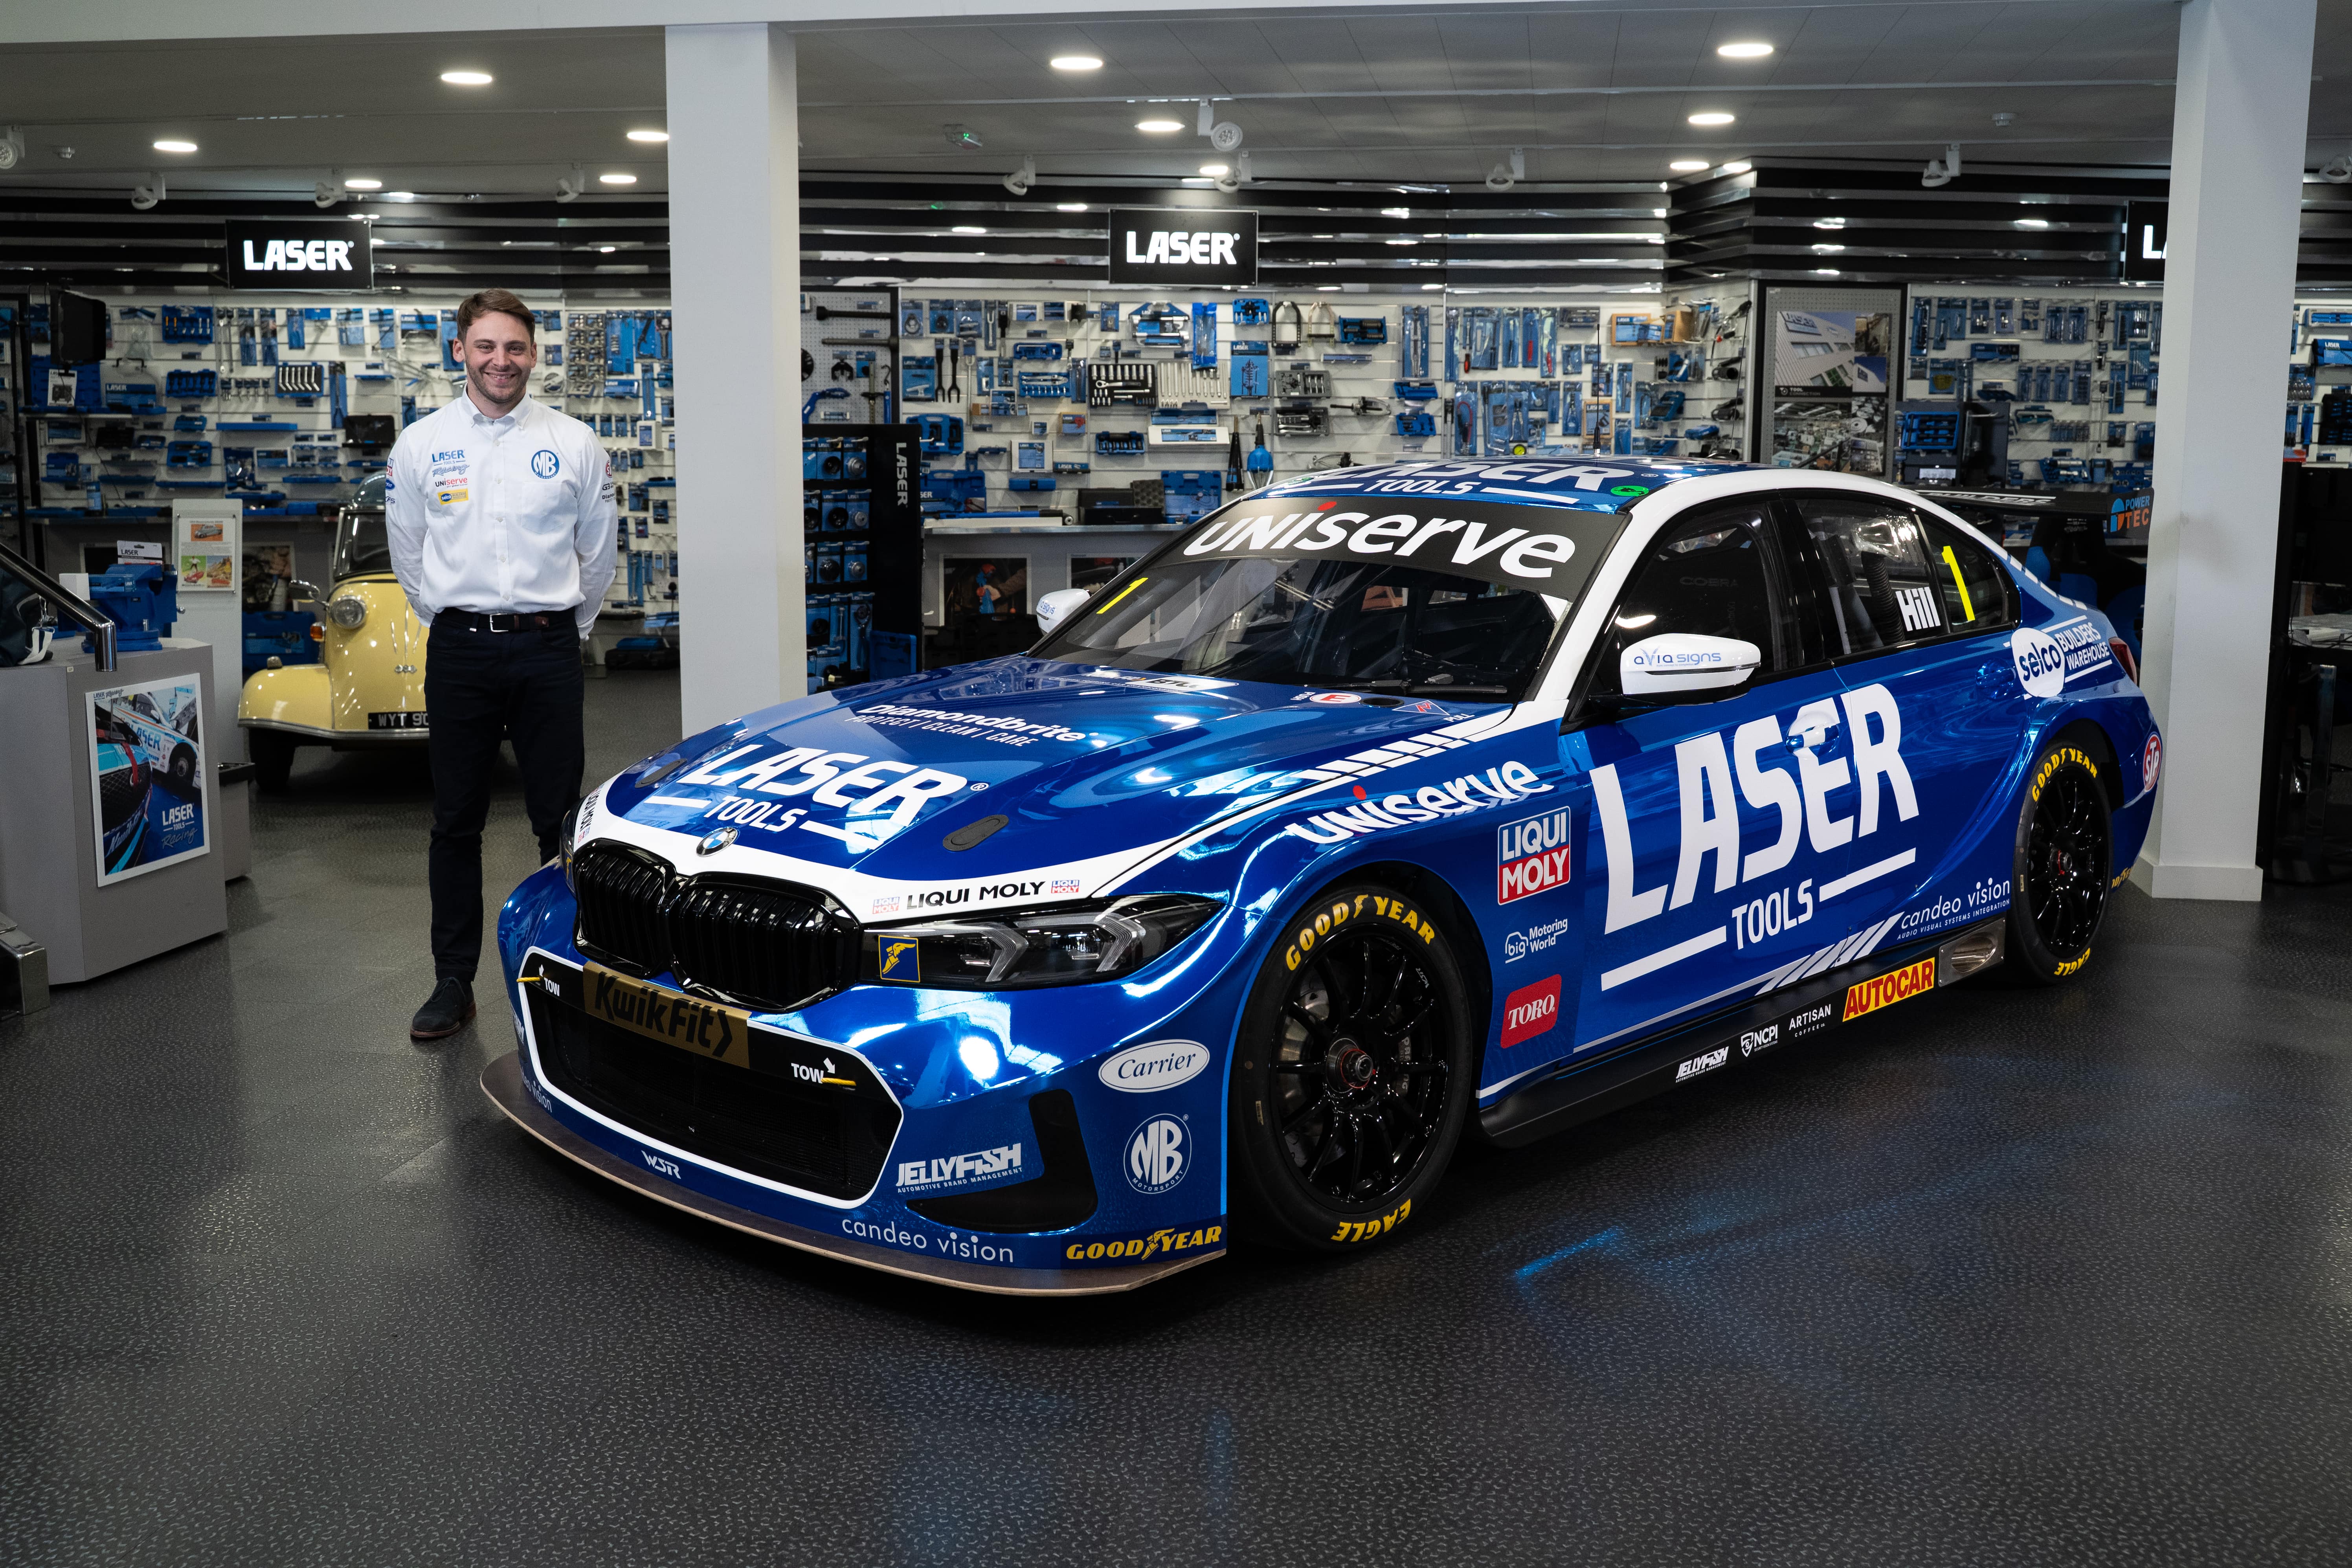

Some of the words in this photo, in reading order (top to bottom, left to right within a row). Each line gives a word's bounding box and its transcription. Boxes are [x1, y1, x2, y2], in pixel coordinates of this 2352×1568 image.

[243, 240, 353, 271] LASER
[1126, 231, 1237, 265] LASER
[431, 449, 465, 463] LASER
[896, 442, 908, 507] LASER
[1364, 479, 1482, 494] TOOLS
[441, 493, 452, 501] selco
[2125, 495, 2150, 510] POWER
[2125, 508, 2149, 529] TEC
[1096, 577, 1148, 614] 1
[1941, 545, 1975, 621] 1
[1895, 586, 1941, 632] Hill
[2054, 622, 2100, 652] BUILDERS
[1676, 652, 1722, 665] signs
[2018, 633, 2061, 681] selco
[2066, 642, 2110, 670] WAREHOUSE
[378, 713, 407, 726] WYT
[844, 715, 921, 727] PROTECT
[922, 719, 977, 736] CLEAN
[986, 732, 1039, 747] CARE
[856, 704, 1087, 742] Diamondbrite
[1443, 713, 1475, 722] PULL
[2145, 740, 2160, 786] STP
[676, 744, 968, 827] LASER
[162, 803, 194, 826] LASER
[704, 795, 808, 832] TOOLS
[1589, 683, 1920, 935] LASER
[162, 827, 198, 850] Racing
[173, 821, 185, 831] TOOLS
[1502, 811, 1567, 861] LIQUI
[1502, 849, 1568, 900] MOLY
[907, 888, 970, 910] LIQUI
[979, 881, 1046, 900] MOLY
[1901, 895, 1961, 929] candeo
[1968, 877, 2010, 907] vision
[1731, 879, 1813, 950] TOOLS
[1897, 929, 1918, 940] AUDIO
[1920, 924, 1943, 934] VISUAL
[1944, 913, 1971, 926] SYSTEMS
[1973, 898, 2010, 917] INTEGRATION
[1508, 941, 1526, 959] big
[1529, 918, 1568, 940] Motoring
[1530, 935, 1556, 953] World
[2053, 947, 2091, 976] EAGLE
[543, 977, 560, 997] TOW
[1844, 962, 1934, 1020] AUTOCAR
[1508, 994, 1553, 1030] TORO
[1788, 1003, 1831, 1031] ARTISAN
[1754, 1024, 1778, 1047] NCPI
[1795, 1025, 1820, 1037] COFFEE
[791, 1062, 824, 1084] TOW
[1118, 1053, 1196, 1080] Carrier
[1675, 1046, 1729, 1079] JELLYFISH
[641, 1150, 681, 1179] WSR
[895, 1142, 1021, 1187] JELLYFISH
[1131, 1120, 1183, 1185] MB
[897, 1183, 941, 1193] AUTOMOTIVE
[944, 1179, 968, 1187] BRAND
[970, 1167, 1023, 1183] MANAGEMENT
[1131, 1170, 1183, 1192] MOTORSPORT
[1330, 1198, 1412, 1243] EAGLE
[842, 1218, 927, 1249] candeo
[938, 1232, 1014, 1263] vision
